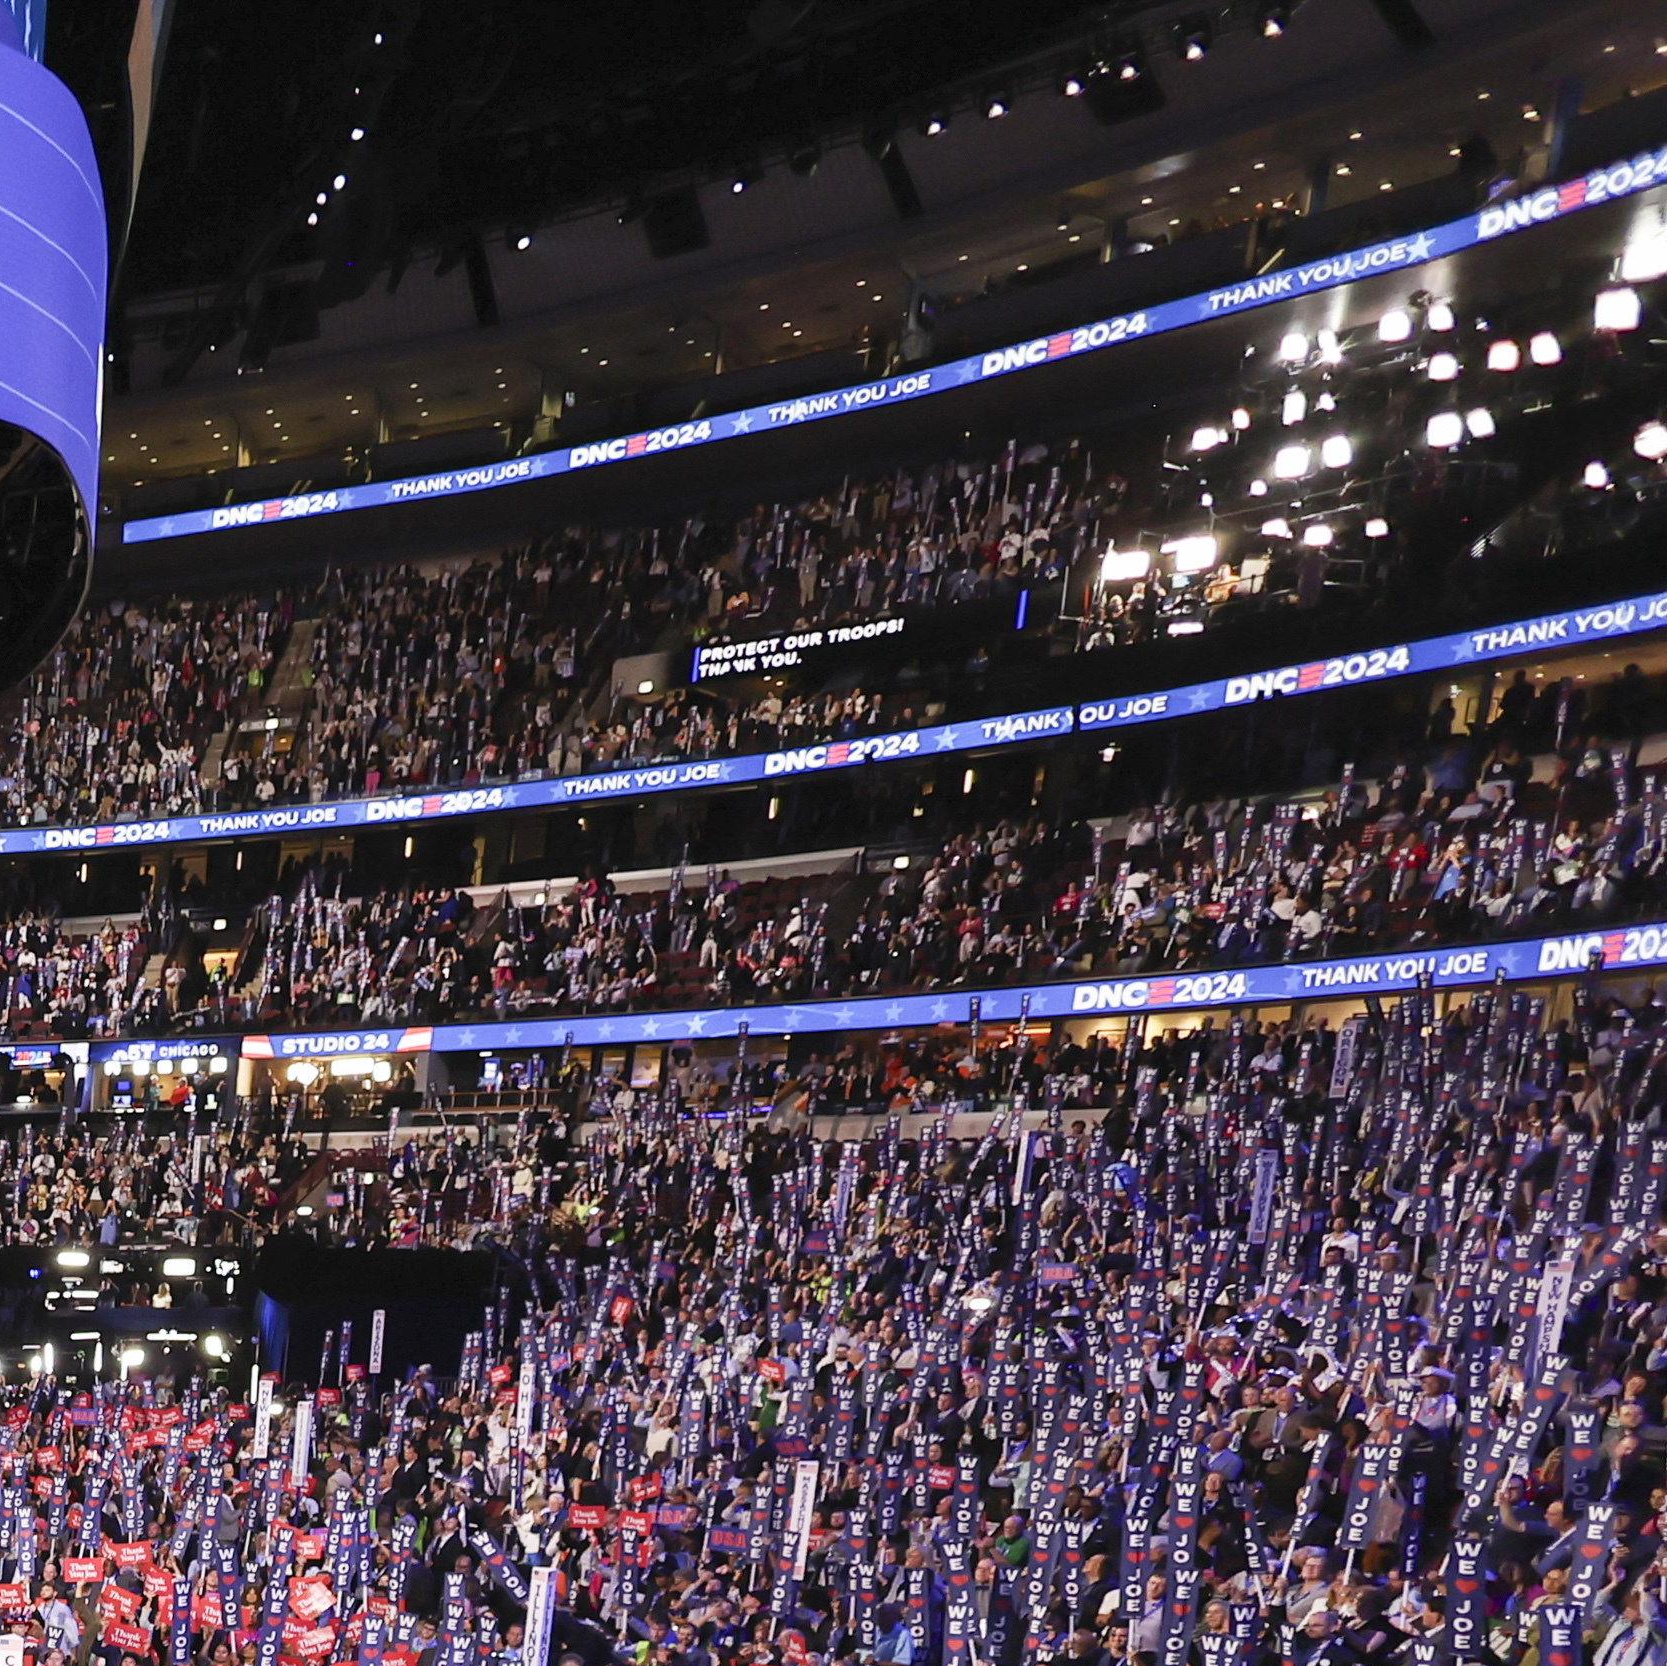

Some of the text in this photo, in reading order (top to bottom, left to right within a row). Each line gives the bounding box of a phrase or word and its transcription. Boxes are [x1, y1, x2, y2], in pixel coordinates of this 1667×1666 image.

[1208, 242, 1408, 311] THANK YOU JOE
[768, 373, 931, 424] THANK YOU JOE
[391, 460, 530, 498] THANK YOU JOE
[700, 618, 904, 663] PROTECT OUR TROOPS!
[1472, 604, 1636, 652] THANK YOU
[760, 651, 803, 670] YOU.
[980, 712, 1061, 742] THANK
[1118, 695, 1168, 718] JOE
[563, 763, 721, 796] THANK YOU JOE
[1302, 962, 1381, 988] THANK
[1438, 952, 1488, 976] JOE
[159, 1043, 219, 1058] CHICAGO
[281, 1036, 362, 1053] STUDIO
